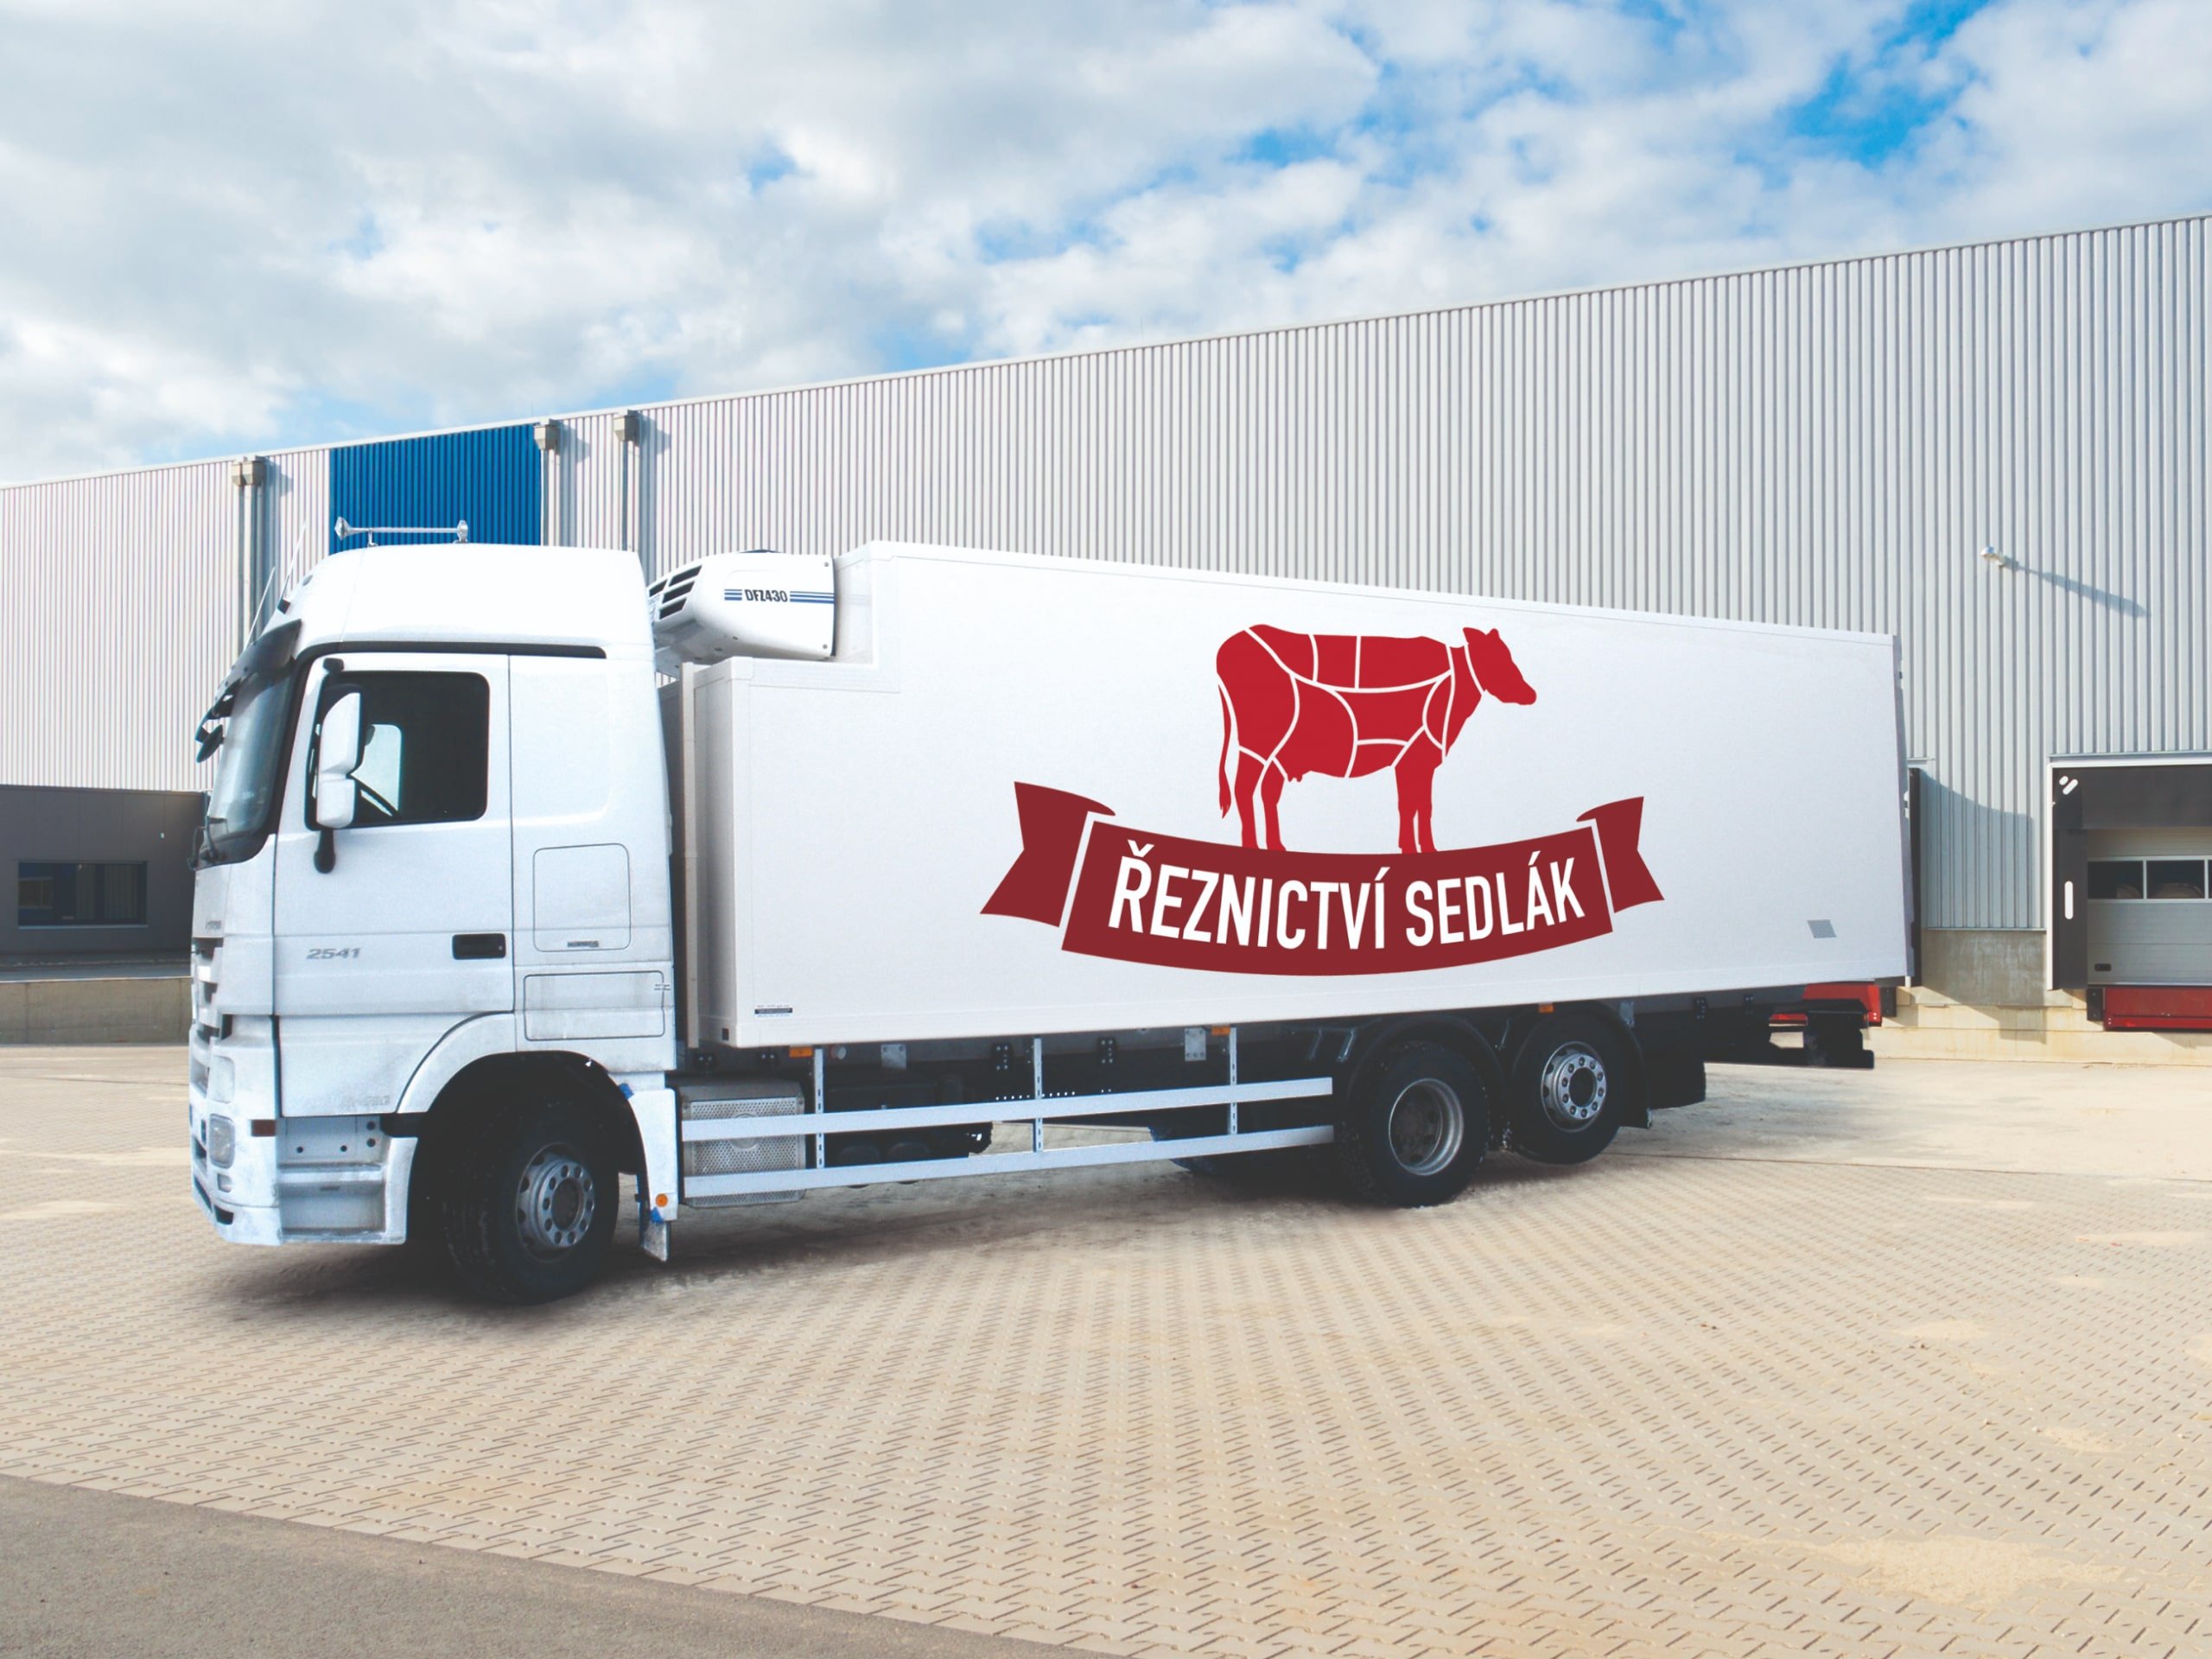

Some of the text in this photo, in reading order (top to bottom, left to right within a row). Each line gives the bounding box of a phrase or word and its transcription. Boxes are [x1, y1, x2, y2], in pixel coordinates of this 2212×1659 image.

[744, 589, 788, 602] DFZ430
[1108, 840, 1586, 950] ŘEZNICTVÍ SEDLÁK
[306, 947, 360, 960] 2541
